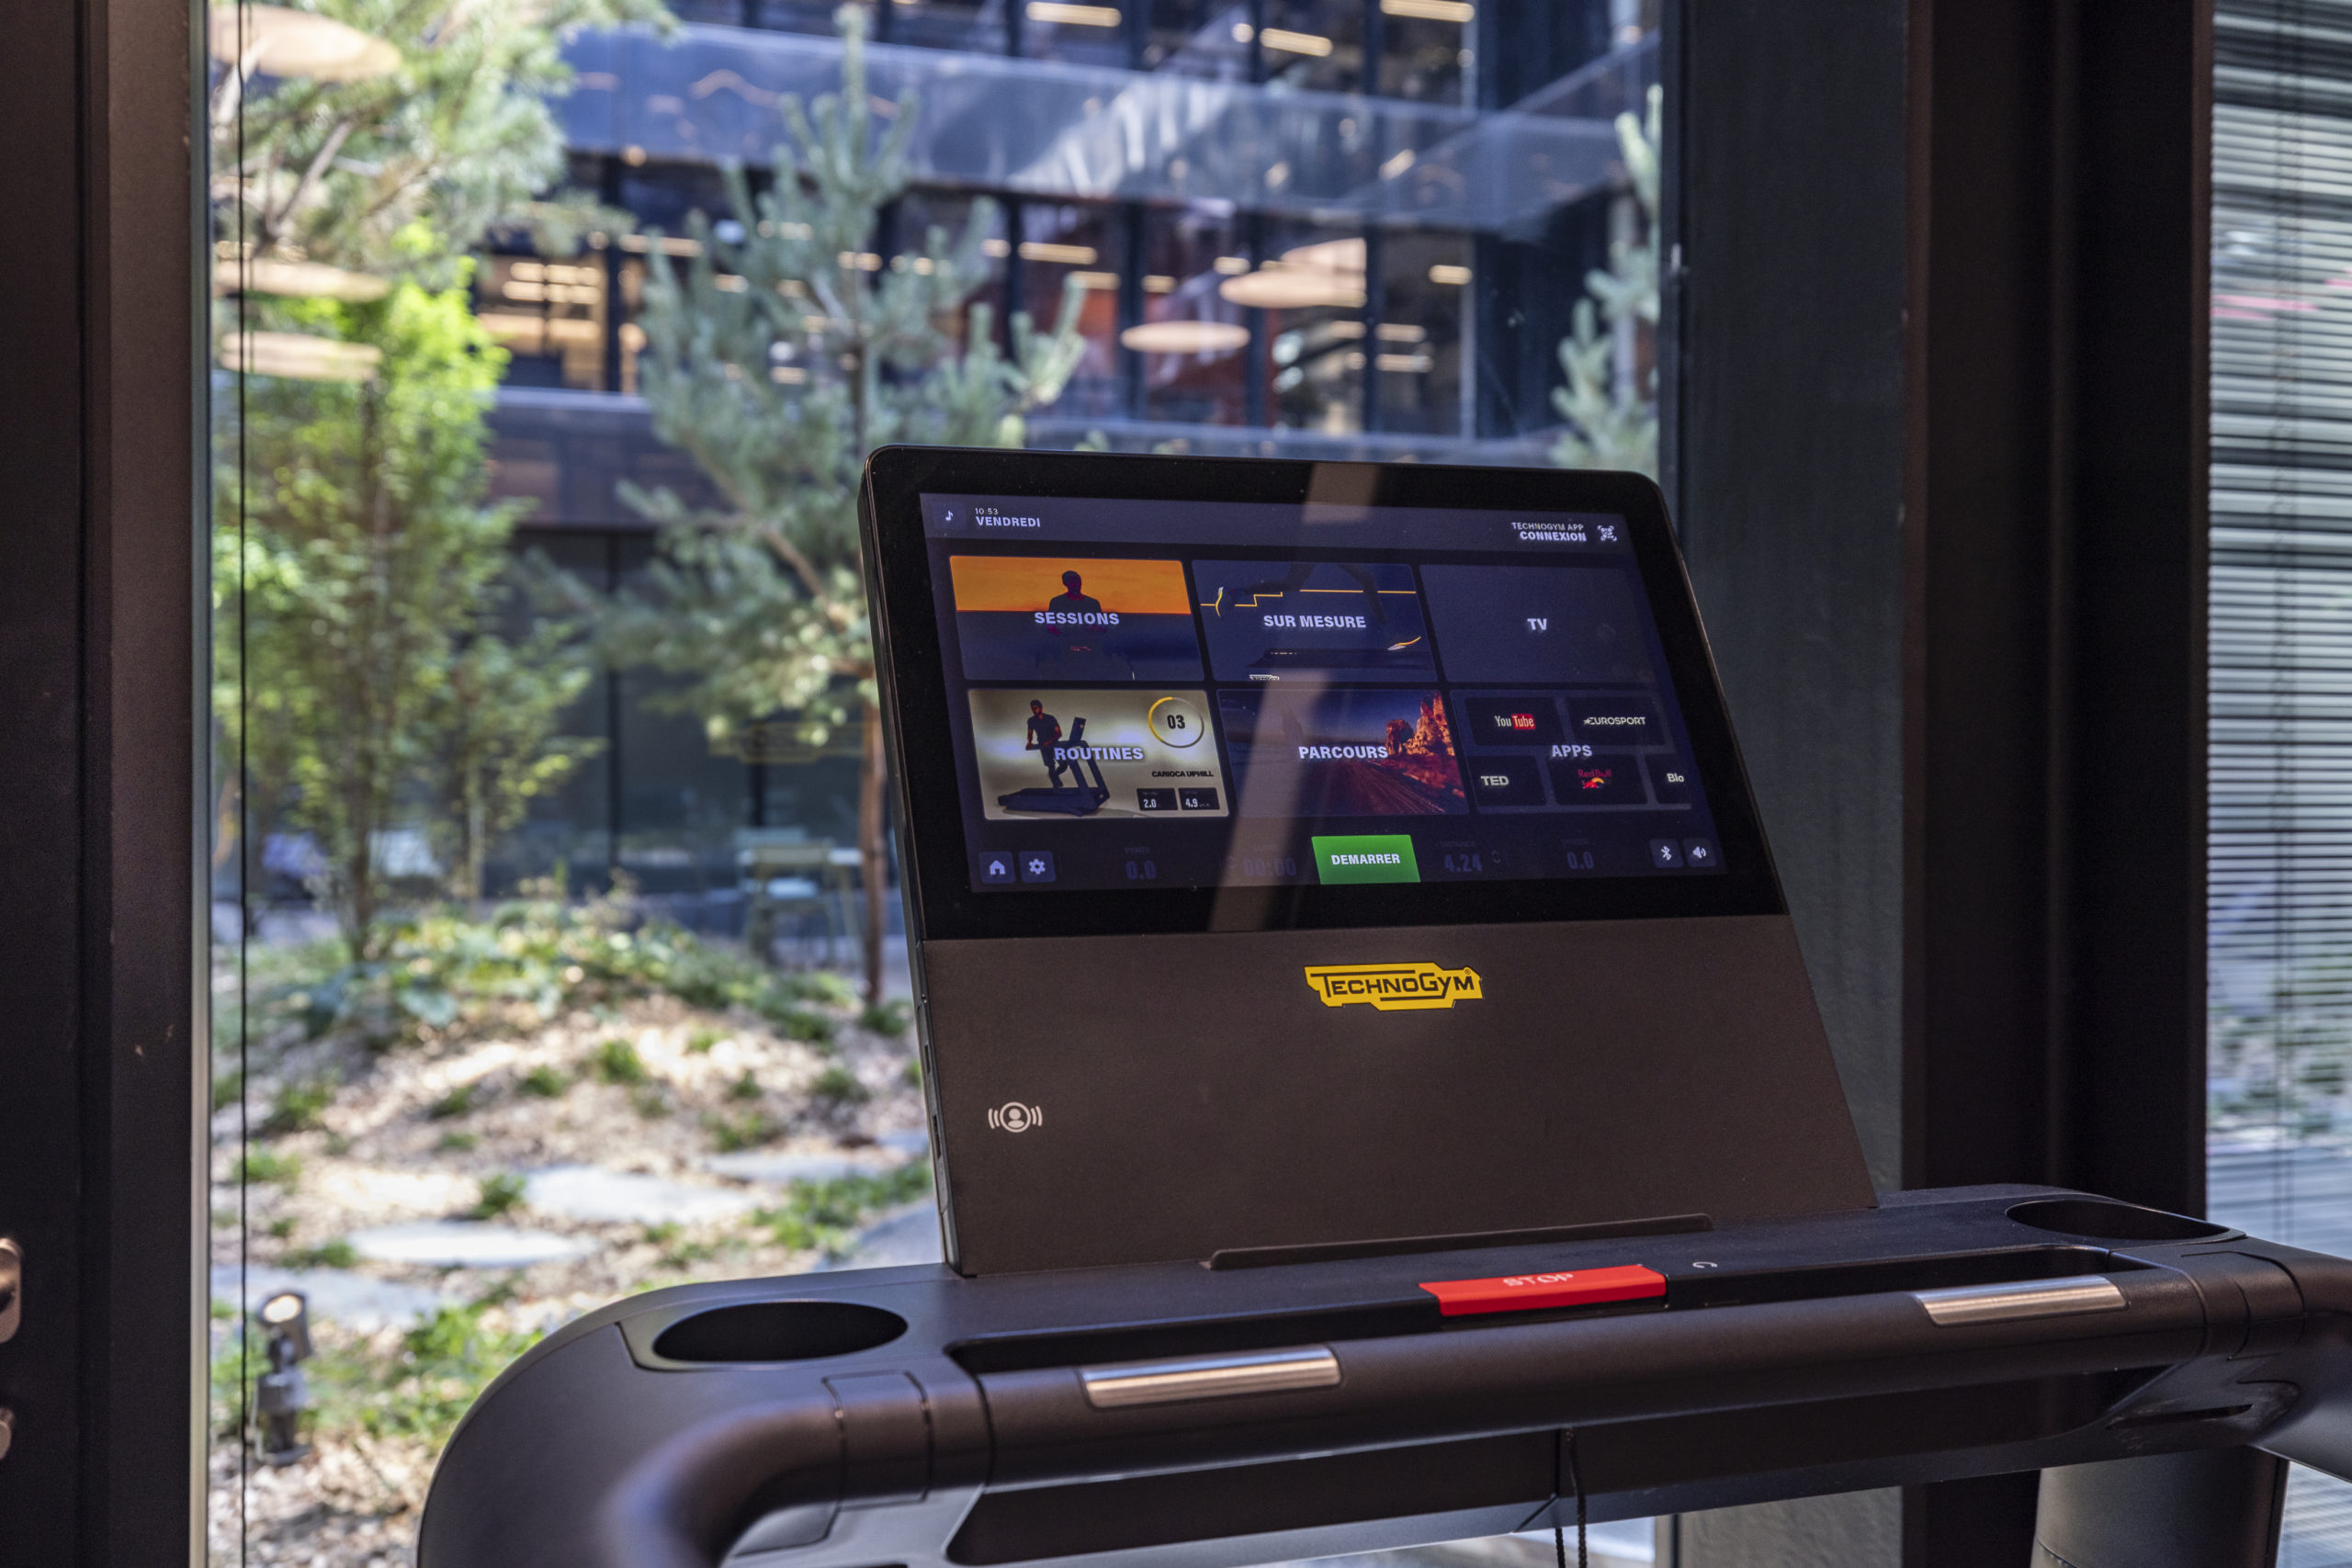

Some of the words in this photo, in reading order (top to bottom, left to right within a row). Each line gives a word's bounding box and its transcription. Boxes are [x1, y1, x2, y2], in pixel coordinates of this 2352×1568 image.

[975, 516, 1041, 528] VENDREDI
[1511, 522, 1566, 531] TECHNOGYM
[1567, 524, 1584, 532] APP
[1520, 531, 1588, 542] CONNEXION
[1034, 611, 1120, 626] SESSIONS
[1263, 615, 1297, 628] SUR
[1300, 615, 1367, 629] MESURE
[1527, 618, 1548, 632] TV
[1167, 715, 1186, 730] 03
[1588, 716, 1646, 726] EUROSPORT
[1053, 747, 1145, 761] ROUTINES
[1298, 745, 1389, 760] PARCOURS
[1551, 745, 1593, 758] APPS
[1186, 770, 1215, 778] UPHILL
[1481, 775, 1510, 786] TED
[1143, 798, 1157, 808] 2.0
[1331, 853, 1401, 865] DEMARRER
[1443, 853, 1483, 873] 4.24
[1566, 852, 1595, 870] 0.0
[1125, 860, 1157, 880] 0.0
[1503, 1273, 1574, 1287] STOP
